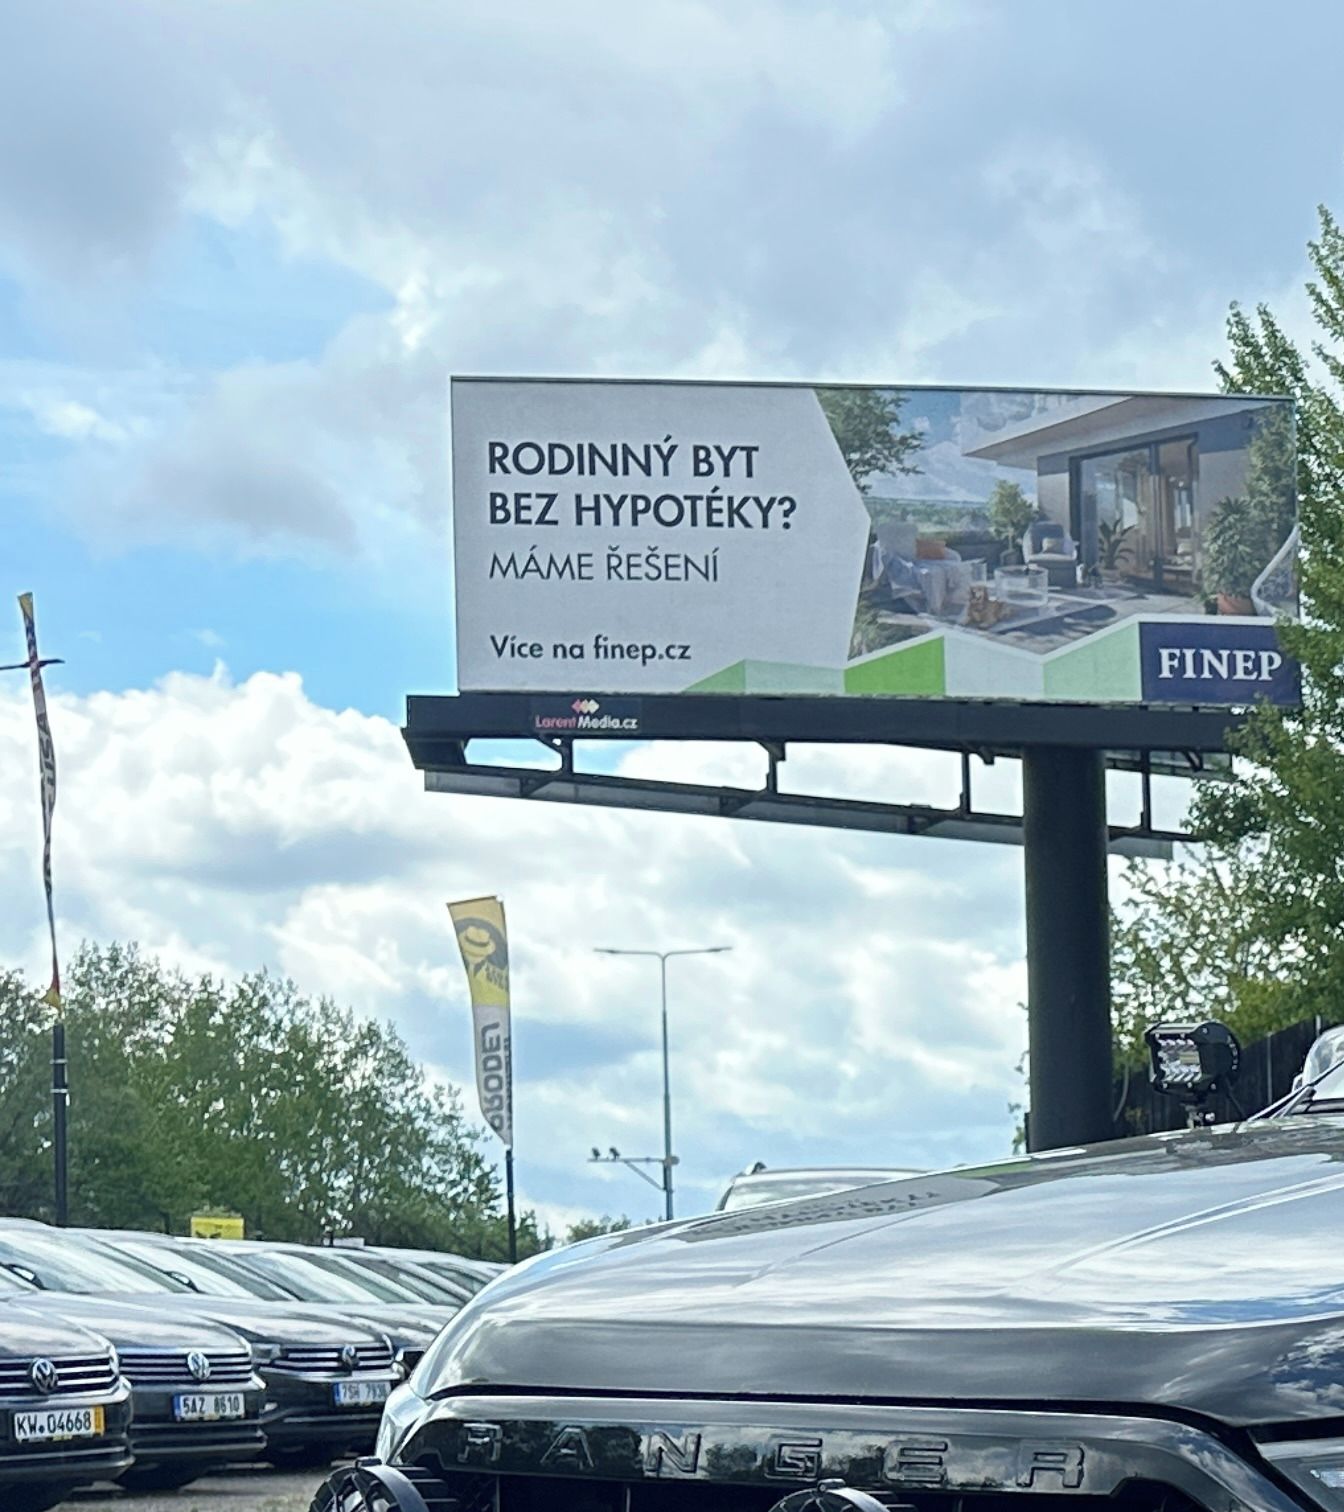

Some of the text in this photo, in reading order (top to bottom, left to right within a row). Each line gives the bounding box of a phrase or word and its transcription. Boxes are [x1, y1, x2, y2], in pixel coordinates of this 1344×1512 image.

[488, 434, 760, 479] RODINNÝ BYT
[489, 485, 798, 530] BEZ HYPOTÉKY?
[488, 544, 720, 583] MÁME ŘEŠENÍ
[490, 634, 692, 667] Více na finep.cz
[1157, 647, 1283, 682] FINEP
[457, 1420, 1087, 1490] RANGER
